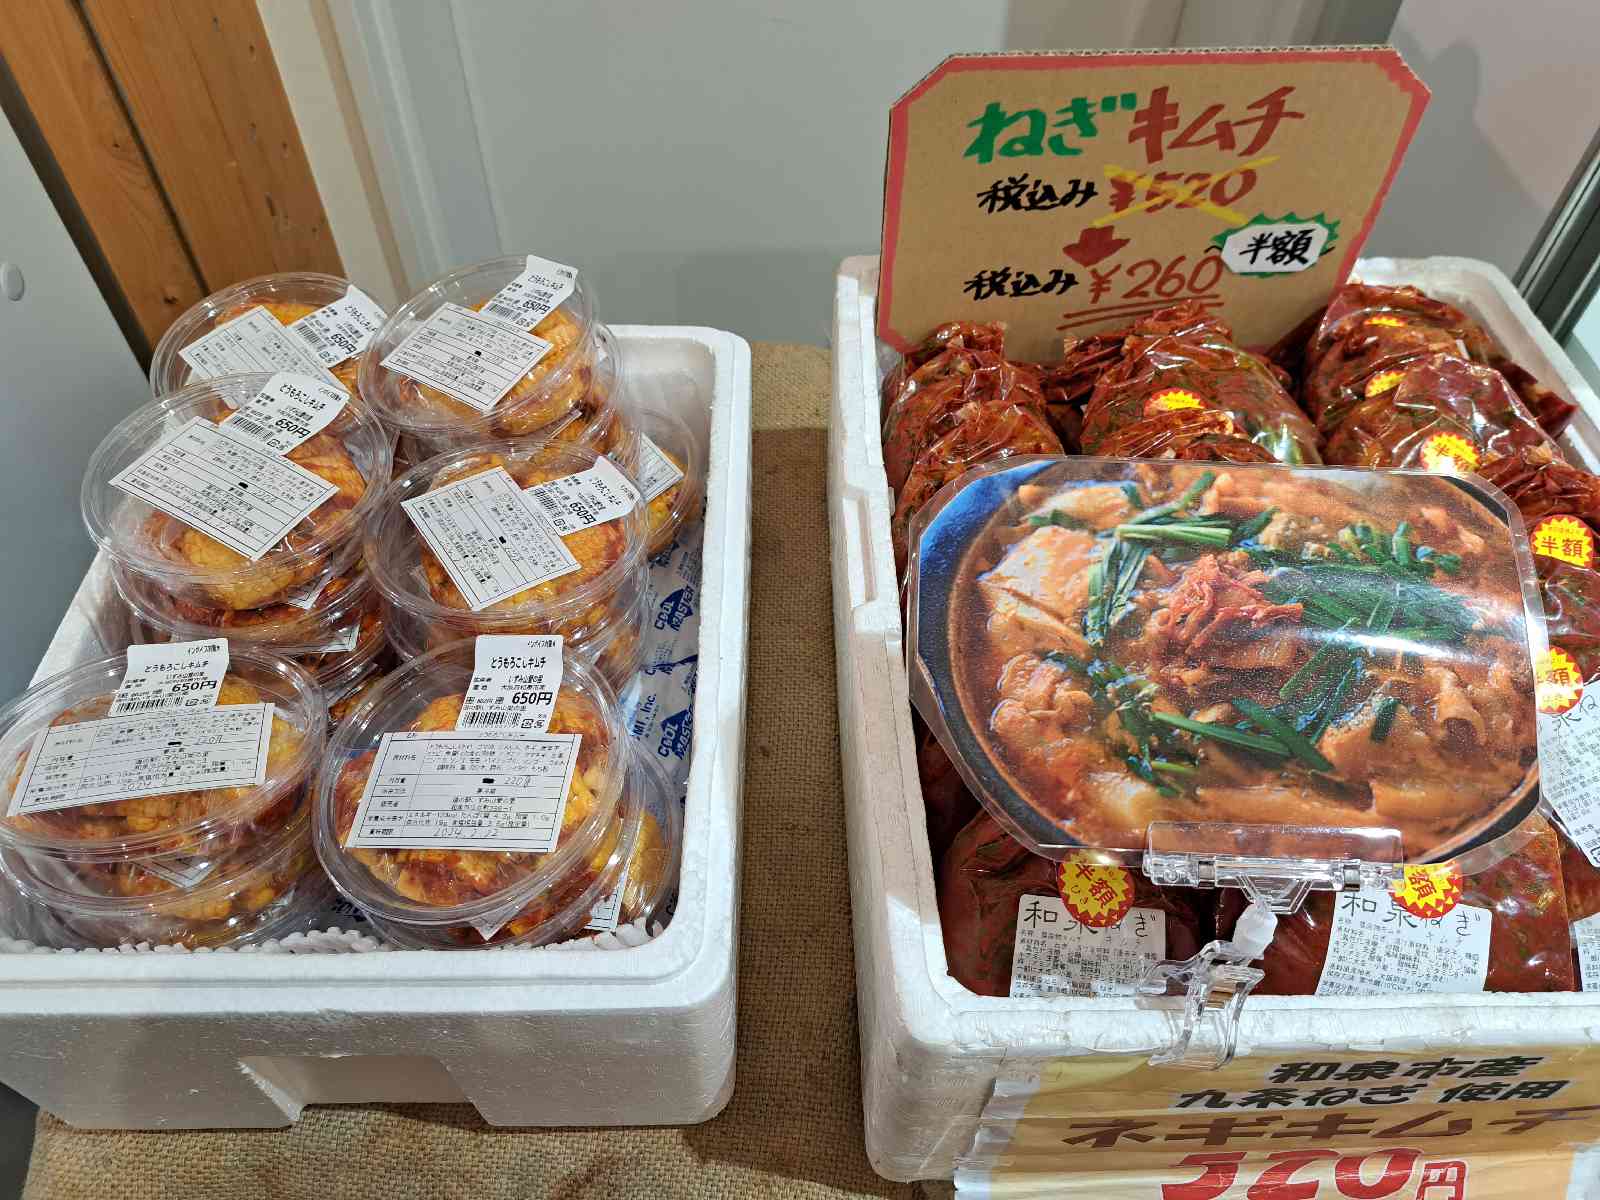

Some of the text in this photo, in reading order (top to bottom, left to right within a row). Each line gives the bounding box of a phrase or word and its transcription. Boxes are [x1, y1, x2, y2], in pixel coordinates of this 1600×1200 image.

[963, 86, 1304, 164] ねぎキムチ
[976, 173, 1098, 214] 税込み
[1238, 228, 1317, 266] 半額
[962, 254, 1224, 304] 税込み ¥260
[331, 332, 358, 355] 650円
[274, 418, 312, 439] 650円
[569, 501, 597, 525] 650円
[1542, 535, 1584, 558] 半額
[144, 660, 209, 673] とうもろこしキムチ
[491, 656, 547, 670] とうもろこしキムチ
[171, 680, 217, 693] 650円
[511, 691, 554, 706] 650円
[657, 722, 679, 758] COOL
[1408, 869, 1437, 900] 額
[1269, 1056, 1545, 1084] 和泉市産
[1174, 1080, 1571, 1110] 九条ねぎ 使用
[1061, 1104, 1600, 1149] ネギキムチ
[1161, 1148, 1468, 1200] 520円
